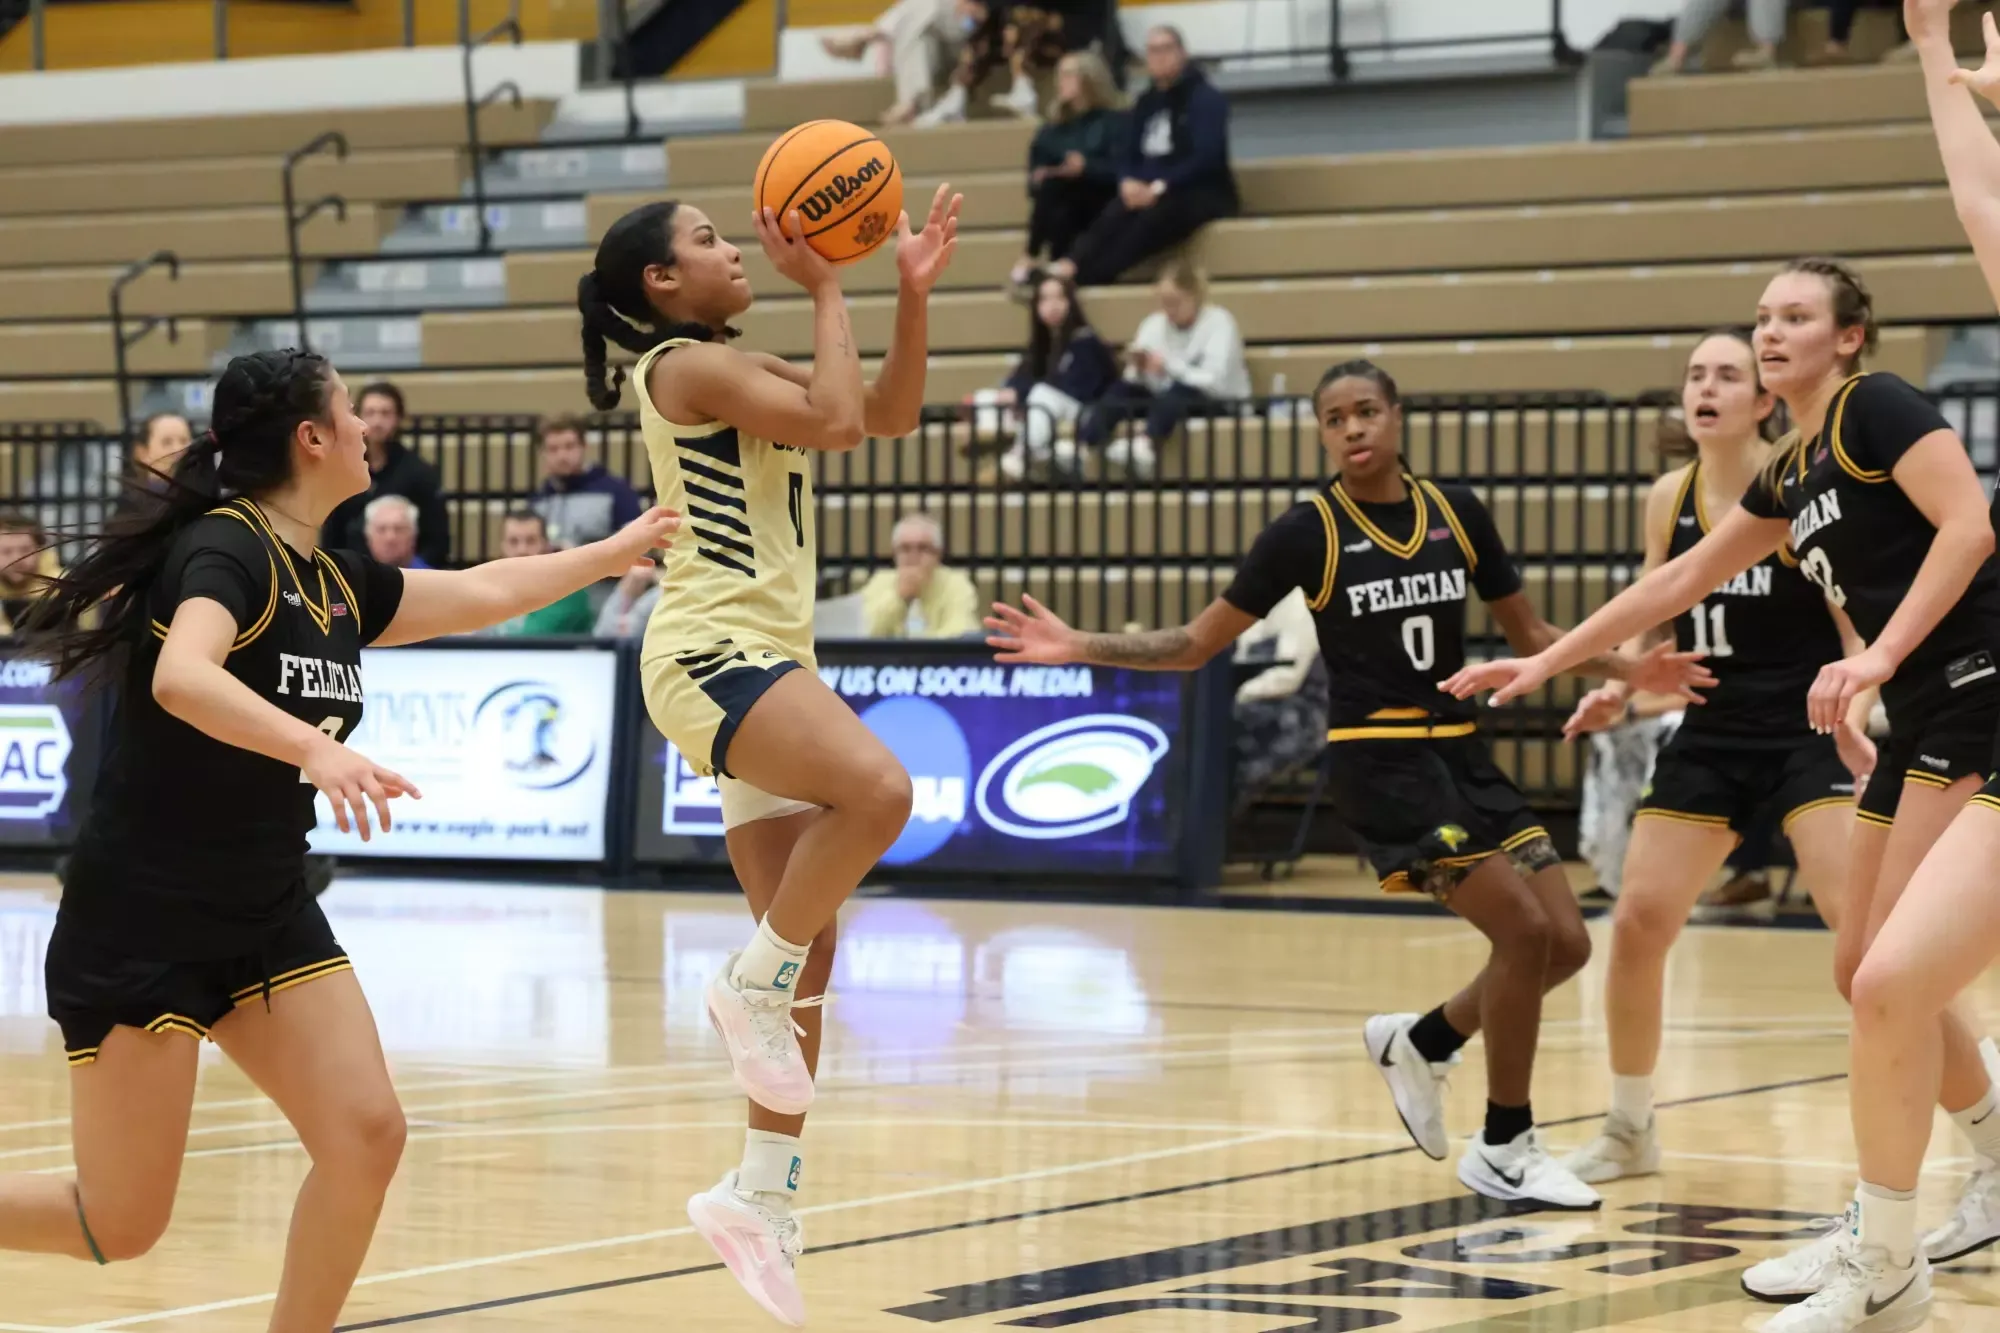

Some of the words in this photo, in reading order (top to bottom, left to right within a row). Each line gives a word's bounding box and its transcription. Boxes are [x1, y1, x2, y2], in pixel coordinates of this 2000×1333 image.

[797, 157, 885, 222] Wilson
[1345, 567, 1467, 617] FELICIAN
[1401, 614, 1435, 671] 0
[1690, 602, 1734, 657] 11
[840, 665, 877, 697] US
[876, 665, 919, 697] ON
[918, 665, 1007, 697] SOCIAL
[1009, 665, 1093, 698] MEDIA
